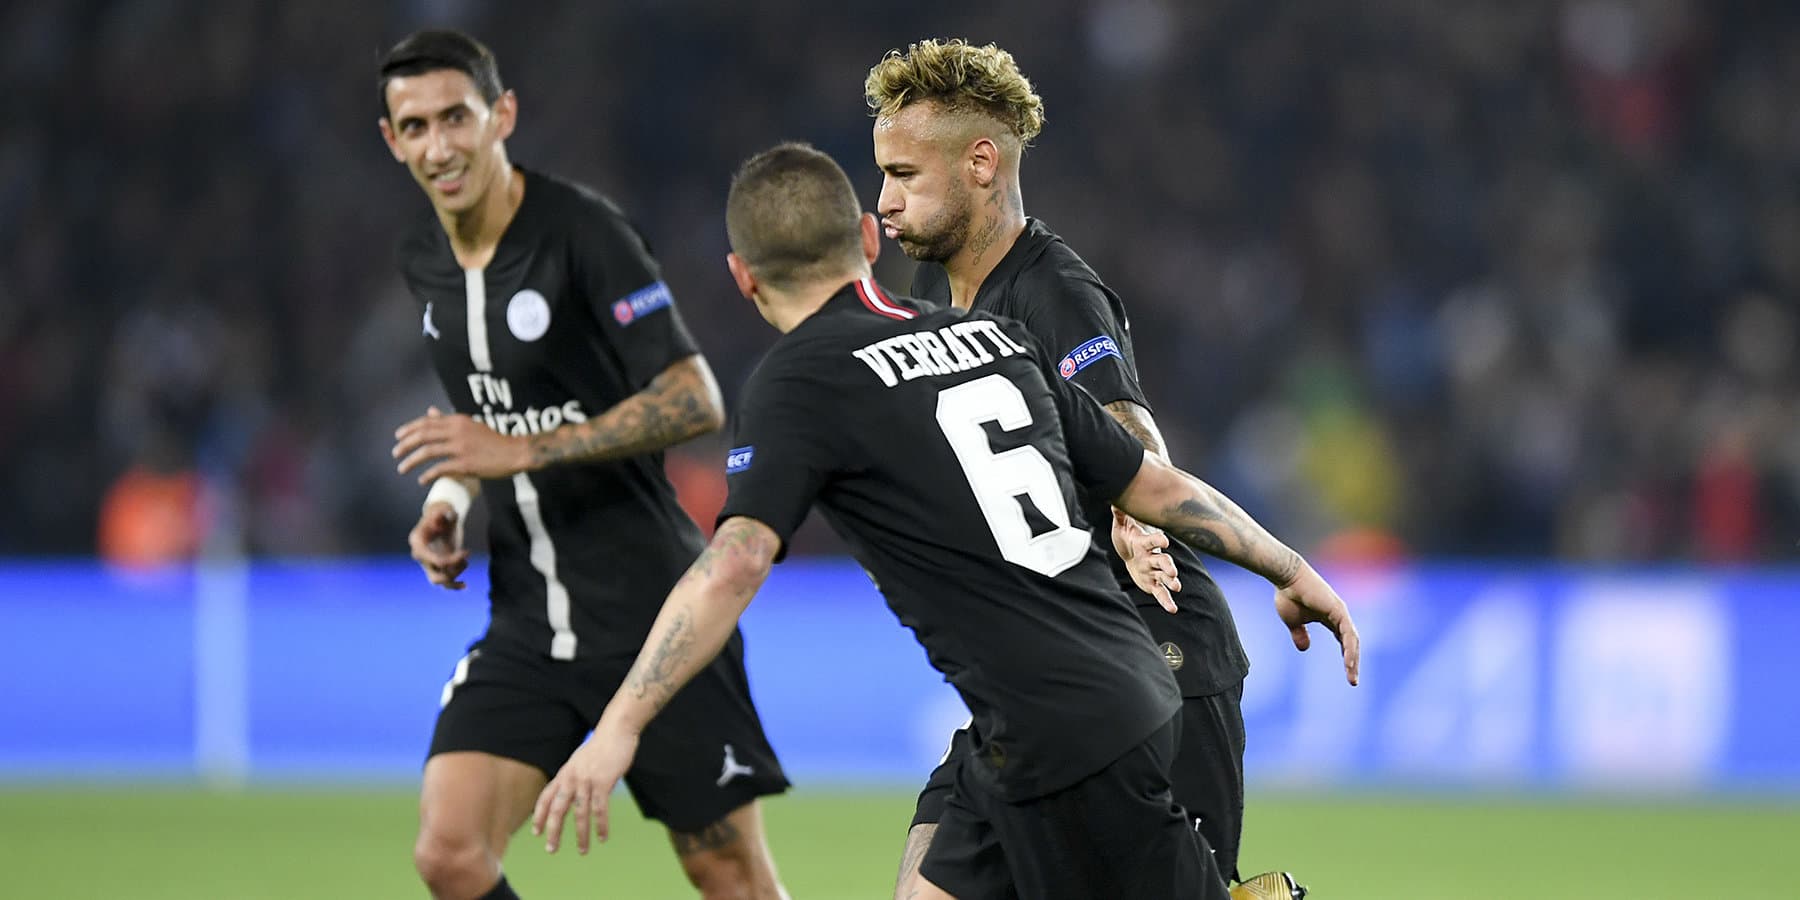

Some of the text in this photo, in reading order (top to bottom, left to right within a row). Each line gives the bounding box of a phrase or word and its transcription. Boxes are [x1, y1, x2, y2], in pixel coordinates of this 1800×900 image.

[467, 373, 513, 411] Fly
[472, 400, 587, 437] irates
[935, 373, 1093, 578] 6
